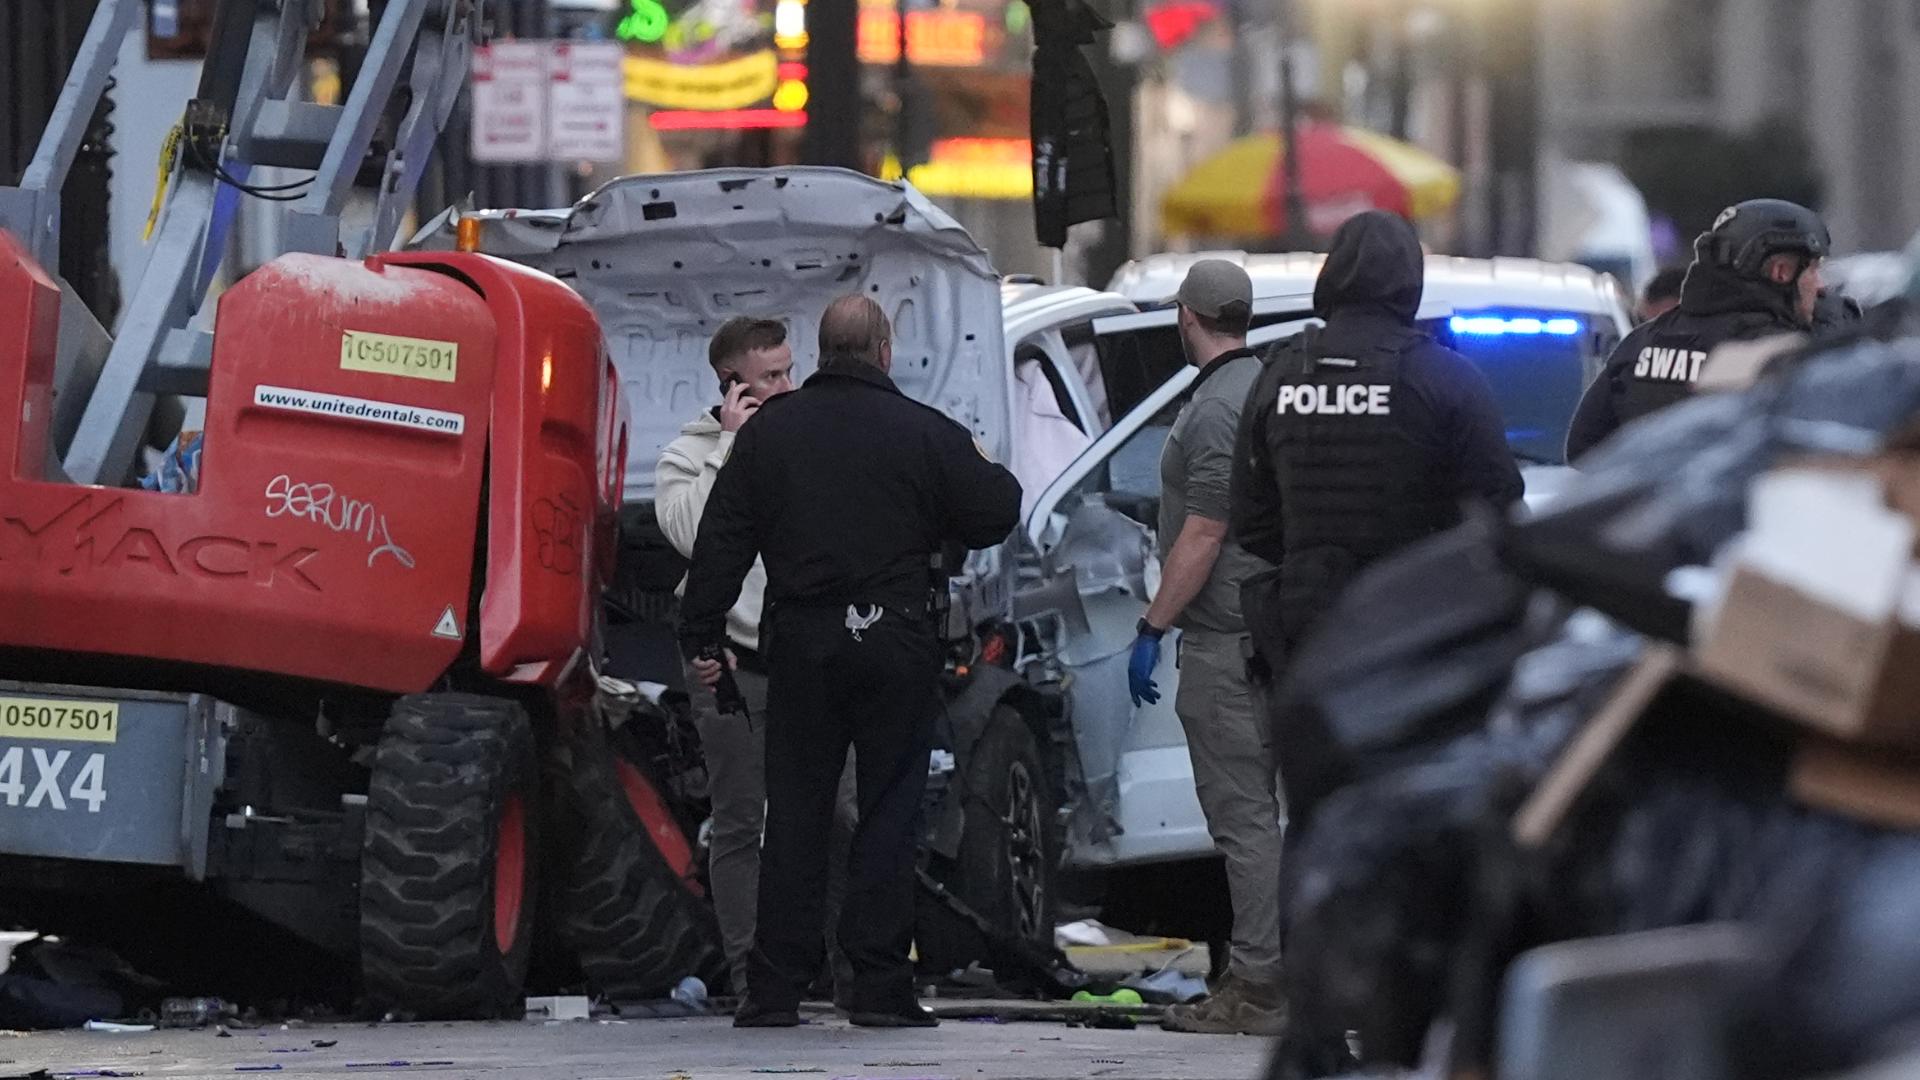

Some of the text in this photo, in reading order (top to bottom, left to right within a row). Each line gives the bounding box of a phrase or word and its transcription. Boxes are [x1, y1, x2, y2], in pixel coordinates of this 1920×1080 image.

[344, 337, 453, 371] 10507501
[1634, 346, 1707, 383] SWAT
[259, 391, 460, 431] www.unitedrentals.com
[1277, 384, 1391, 415] POLICE
[0, 704, 114, 732] 0507501
[0, 746, 107, 813] 4X4
